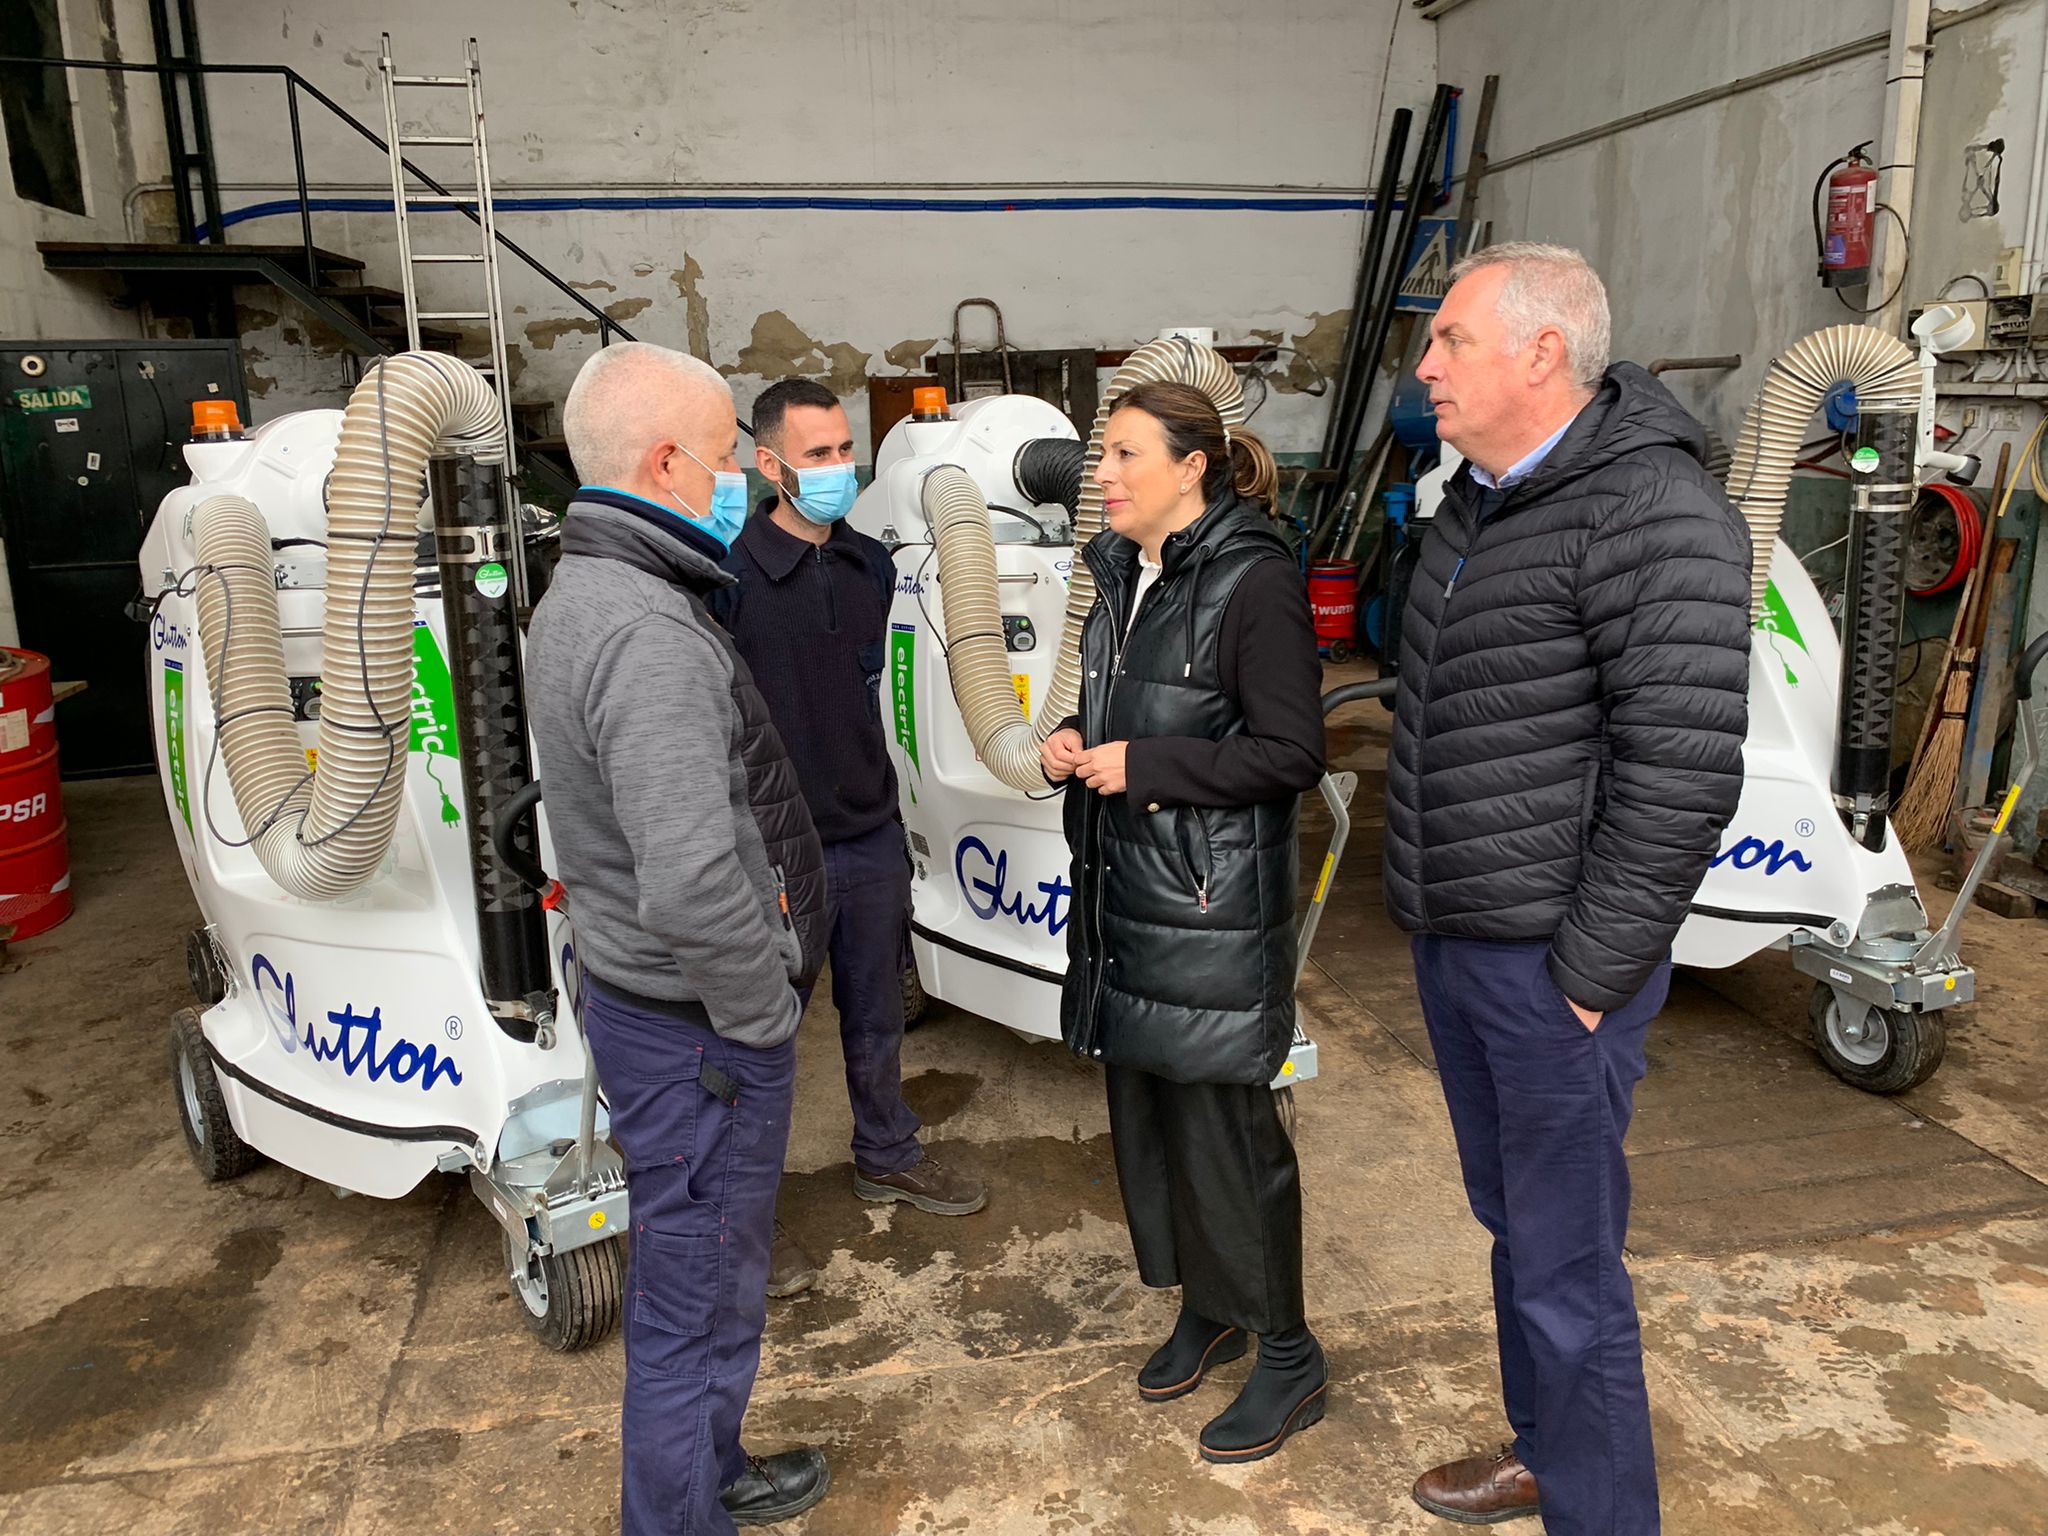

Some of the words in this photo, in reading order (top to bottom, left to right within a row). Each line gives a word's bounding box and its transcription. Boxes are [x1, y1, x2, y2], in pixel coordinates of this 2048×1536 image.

[19, 390, 84, 409] SALIDA
[897, 646, 911, 751] electric
[169, 688, 187, 818] electric
